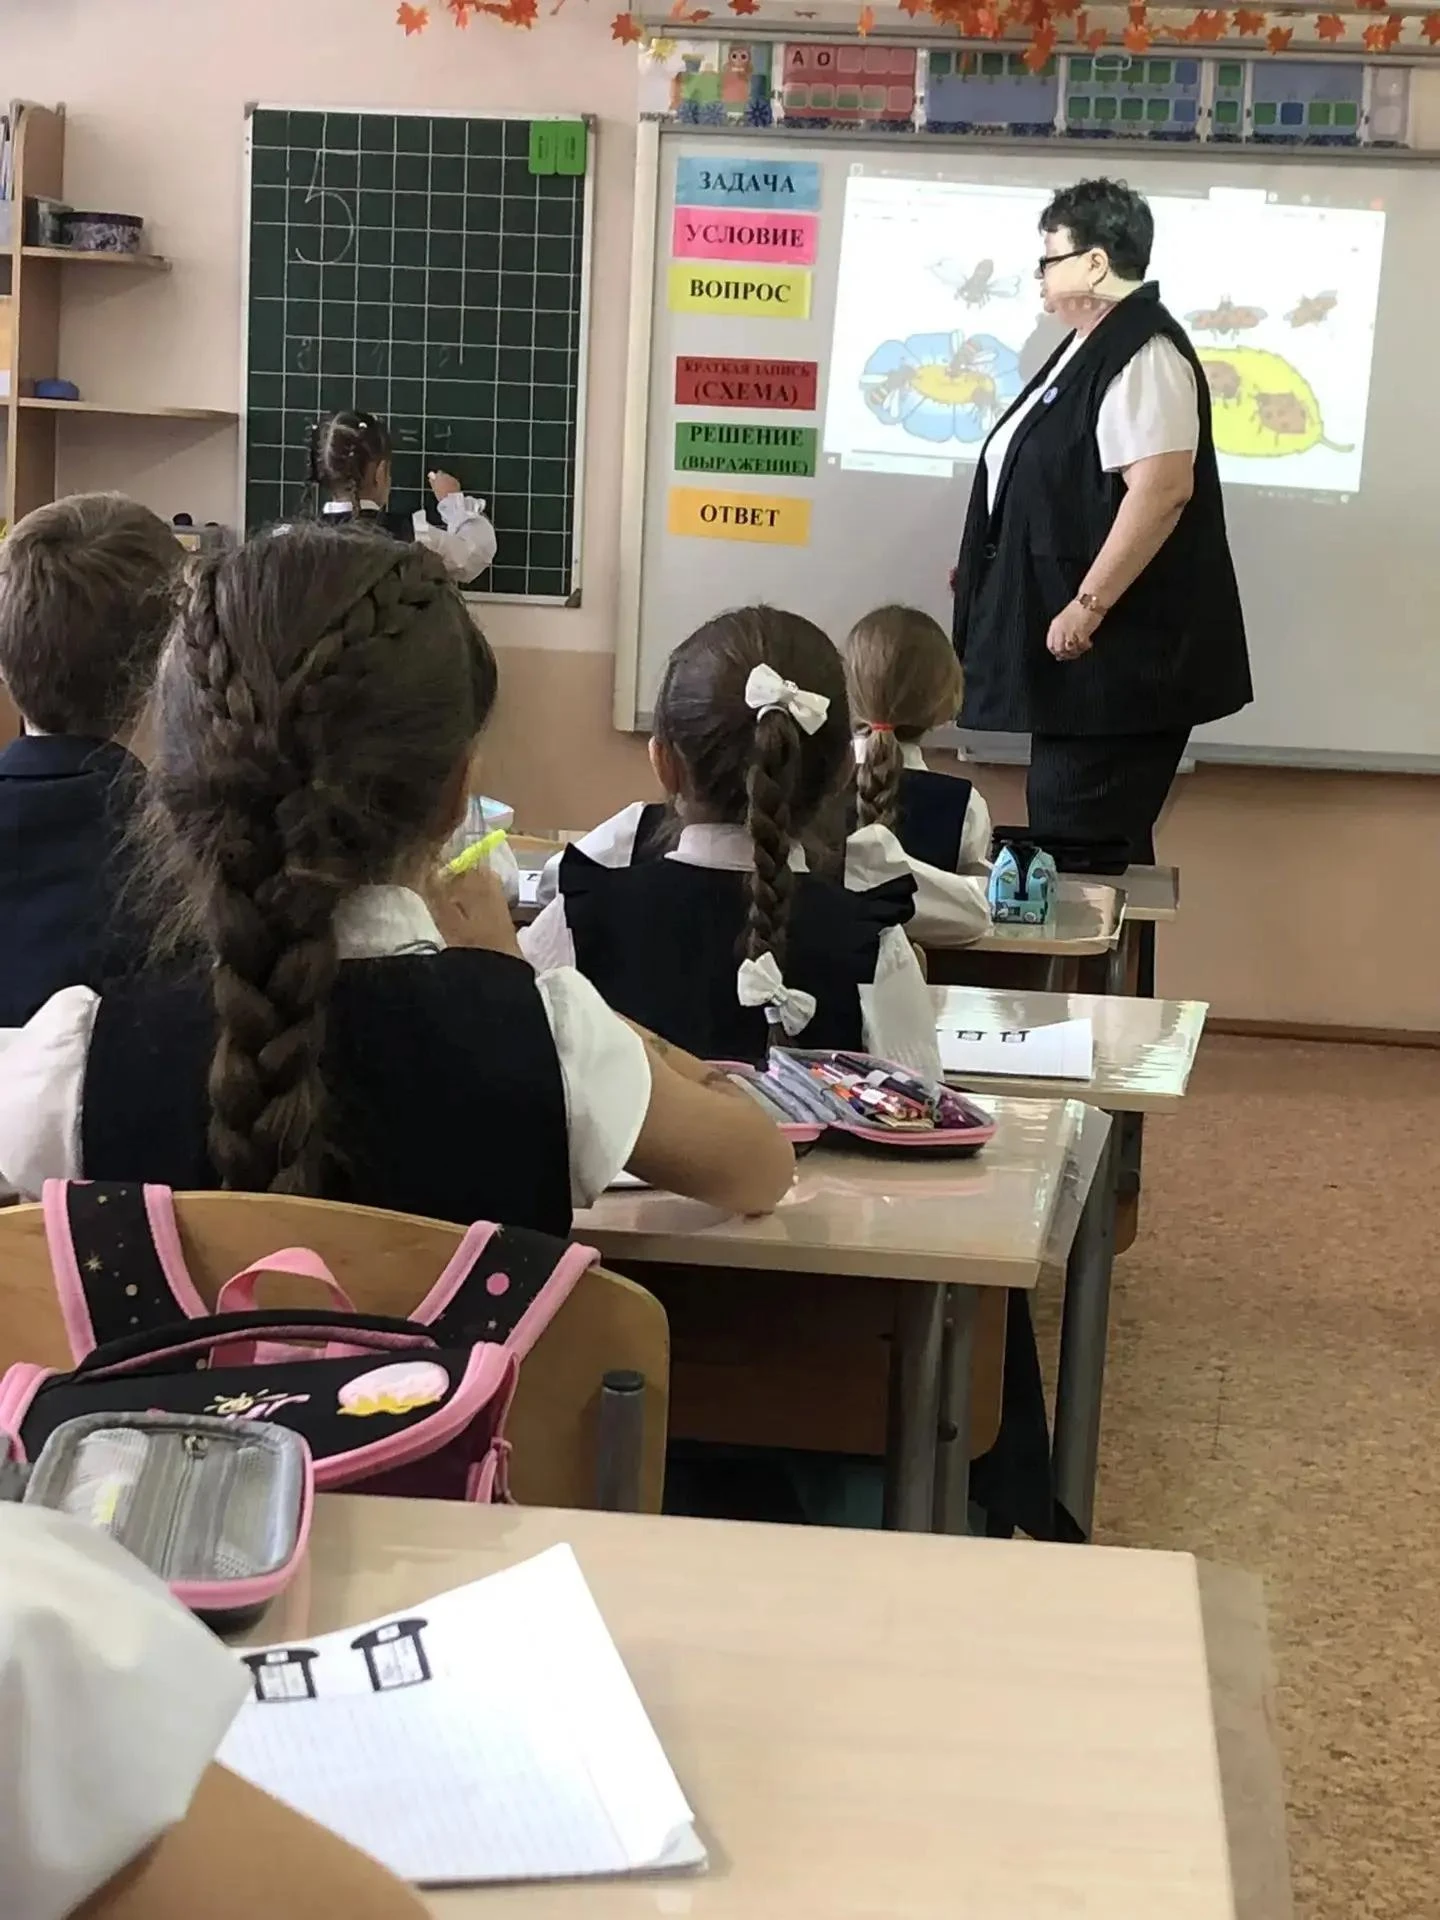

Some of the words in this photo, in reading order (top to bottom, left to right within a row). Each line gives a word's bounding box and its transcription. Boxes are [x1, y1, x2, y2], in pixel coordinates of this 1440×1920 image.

[699, 171, 797, 194] ЗАДАЧА
[295, 148, 360, 265] 5
[685, 223, 805, 248] УСЛОВИЕ
[689, 278, 792, 303] ВОПРОС
[684, 361, 751, 376] КРАТКАЯ
[694, 379, 799, 406] (СХЕМА)
[689, 424, 805, 447] РЕШЕНИЕ
[681, 454, 809, 476] (ВЫРАЖЕНИЕ)
[699, 503, 780, 528] ОТВЕТ
